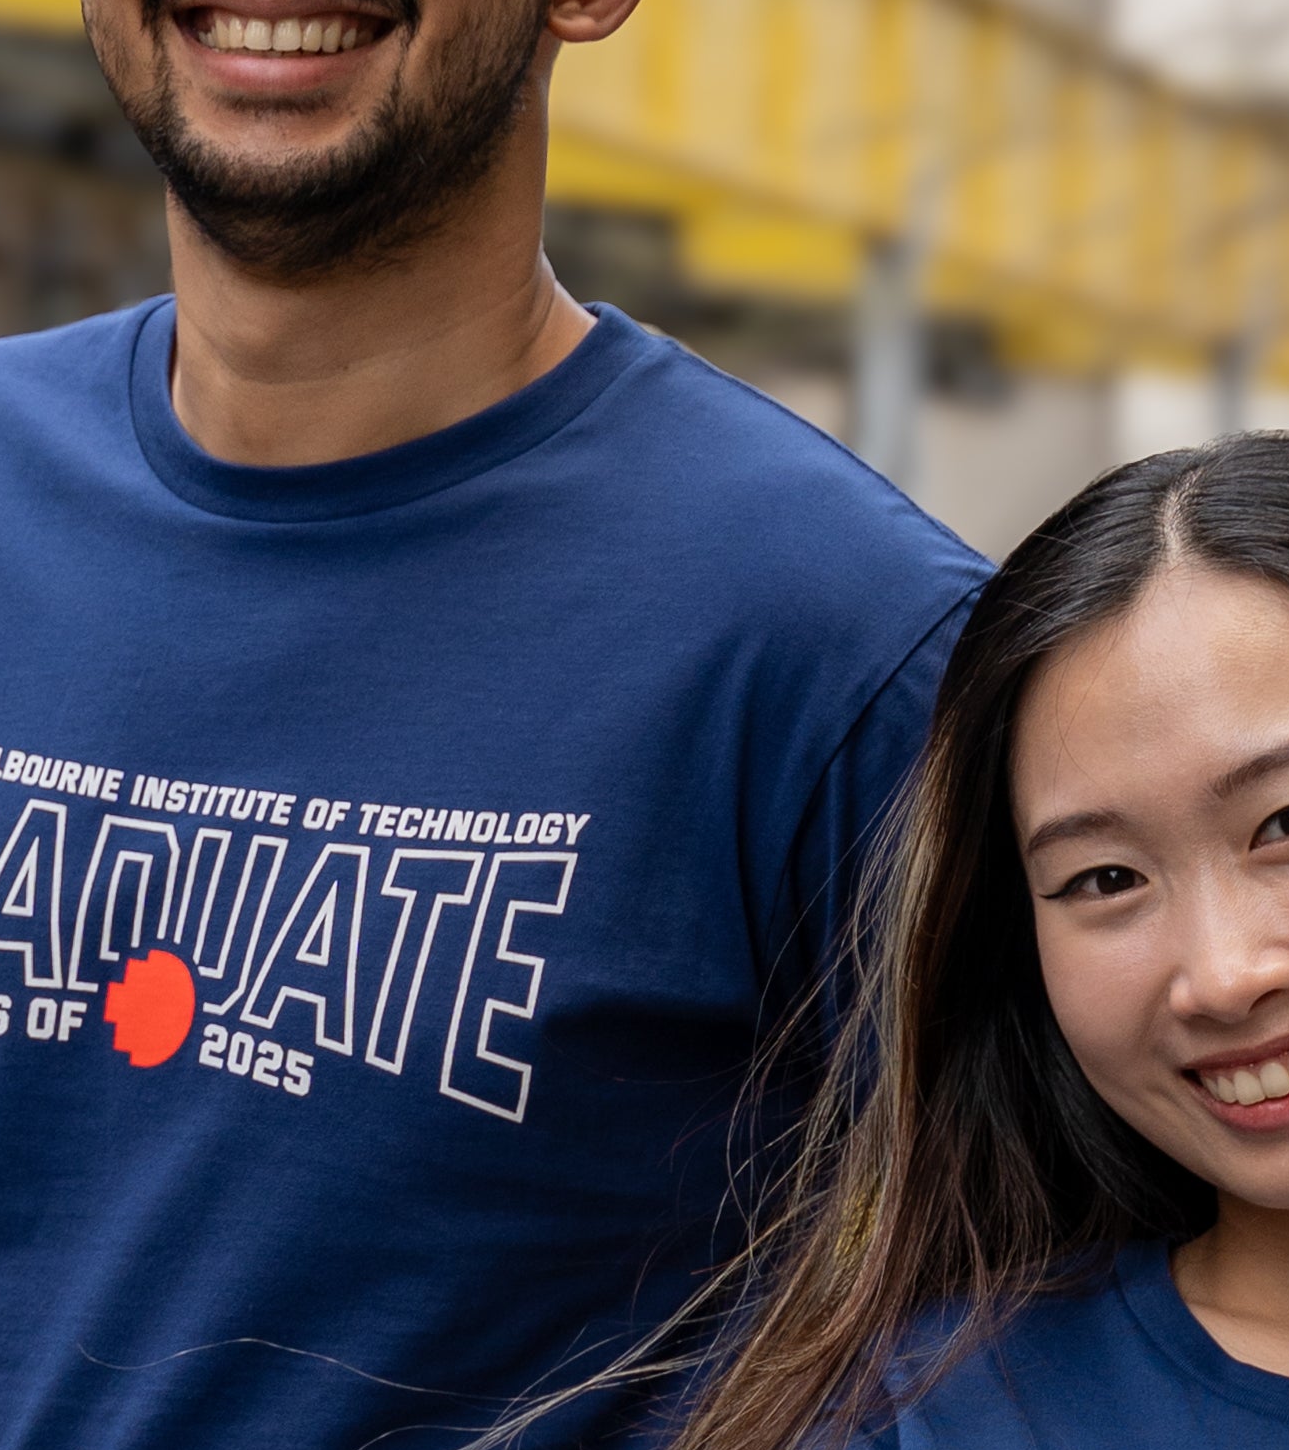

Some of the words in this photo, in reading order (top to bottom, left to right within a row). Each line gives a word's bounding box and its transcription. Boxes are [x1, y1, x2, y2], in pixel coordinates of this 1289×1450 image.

[130, 774, 297, 826] INSTITUTE
[302, 797, 352, 832] OF
[358, 803, 591, 845] TECHNOLOGY
[26, 997, 88, 1042] OF
[198, 1023, 314, 1097] 2025
